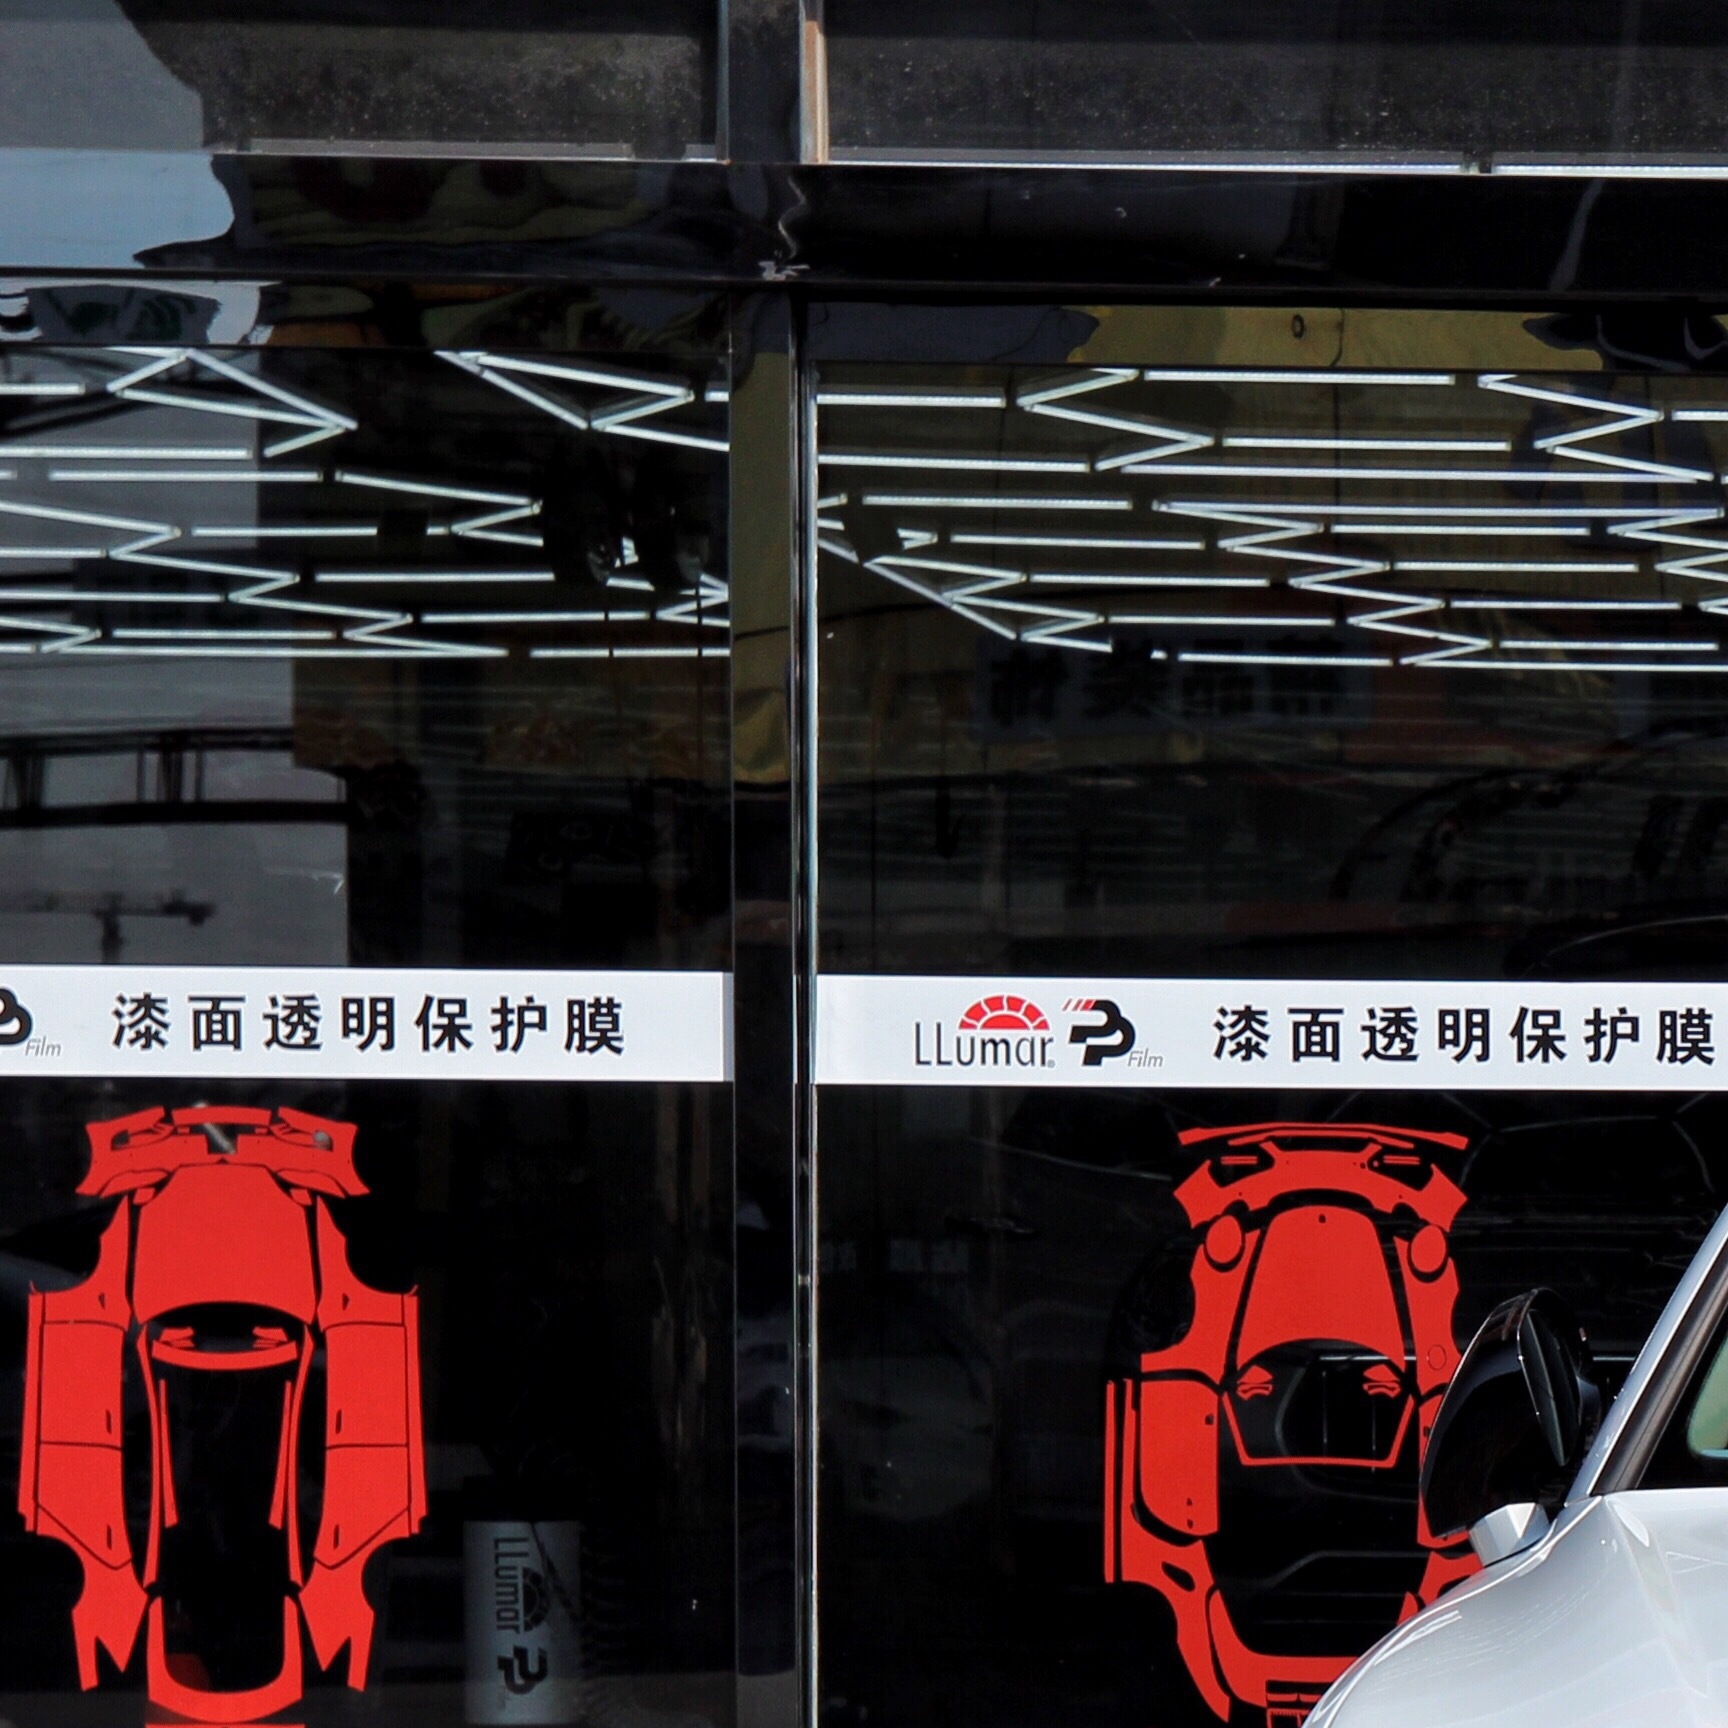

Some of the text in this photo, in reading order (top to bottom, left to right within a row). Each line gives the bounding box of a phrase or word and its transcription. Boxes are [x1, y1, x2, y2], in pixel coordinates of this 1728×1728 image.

[25, 1037, 62, 1058] Film
[112, 992, 626, 1056] 漆面透明保护膜
[914, 1021, 1052, 1068] LLumar
[1128, 1049, 1164, 1069] Film
[1211, 1004, 1717, 1067] 漆面透明保护膜
